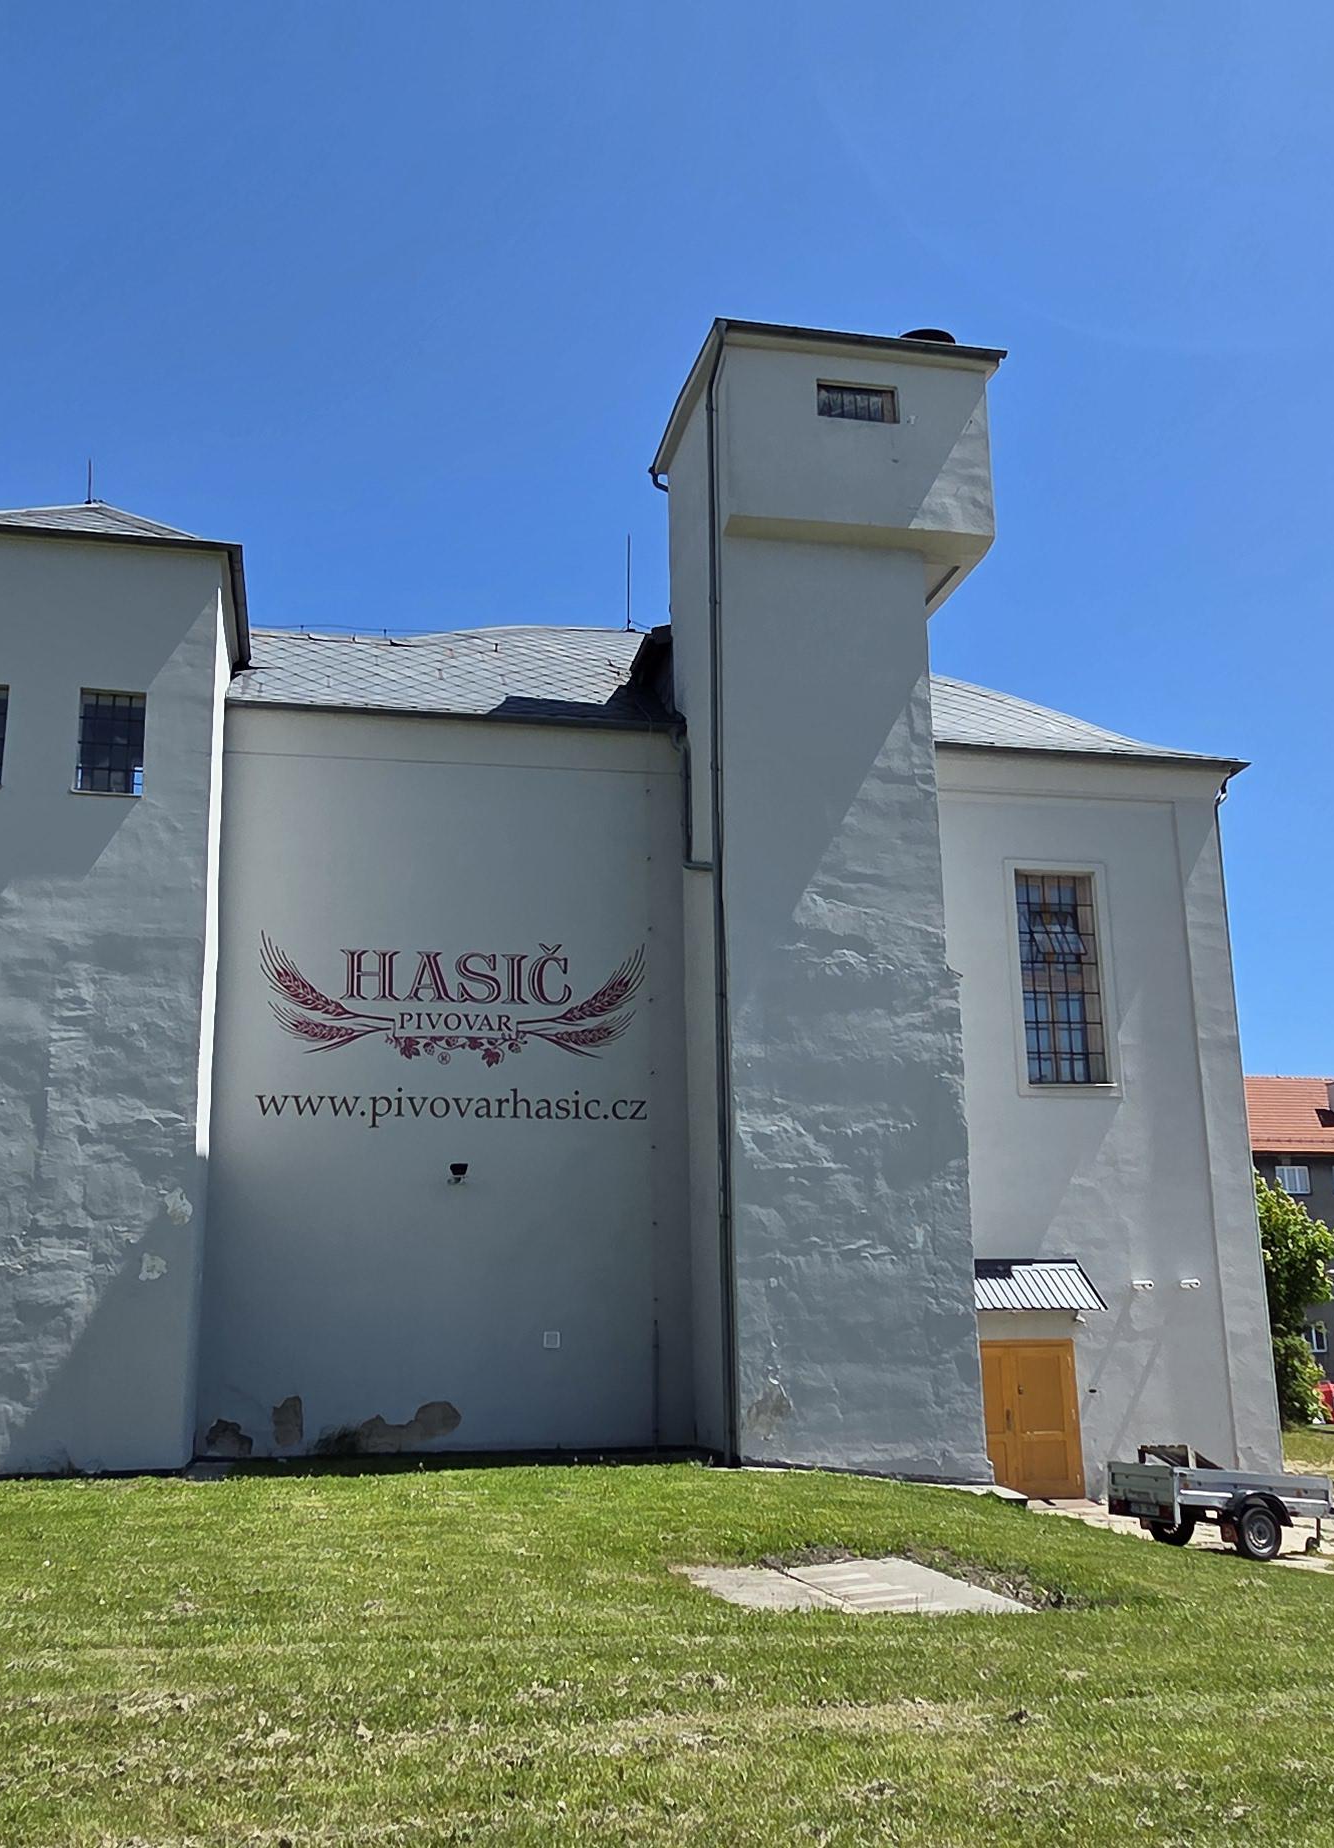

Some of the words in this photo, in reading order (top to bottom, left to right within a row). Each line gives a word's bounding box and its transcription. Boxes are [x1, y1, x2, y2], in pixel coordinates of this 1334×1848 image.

[340, 943, 572, 1006] HASIČ
[398, 1012, 513, 1033] PIVOVAR
[255, 1087, 648, 1129] www.pivovarhasic.cz
